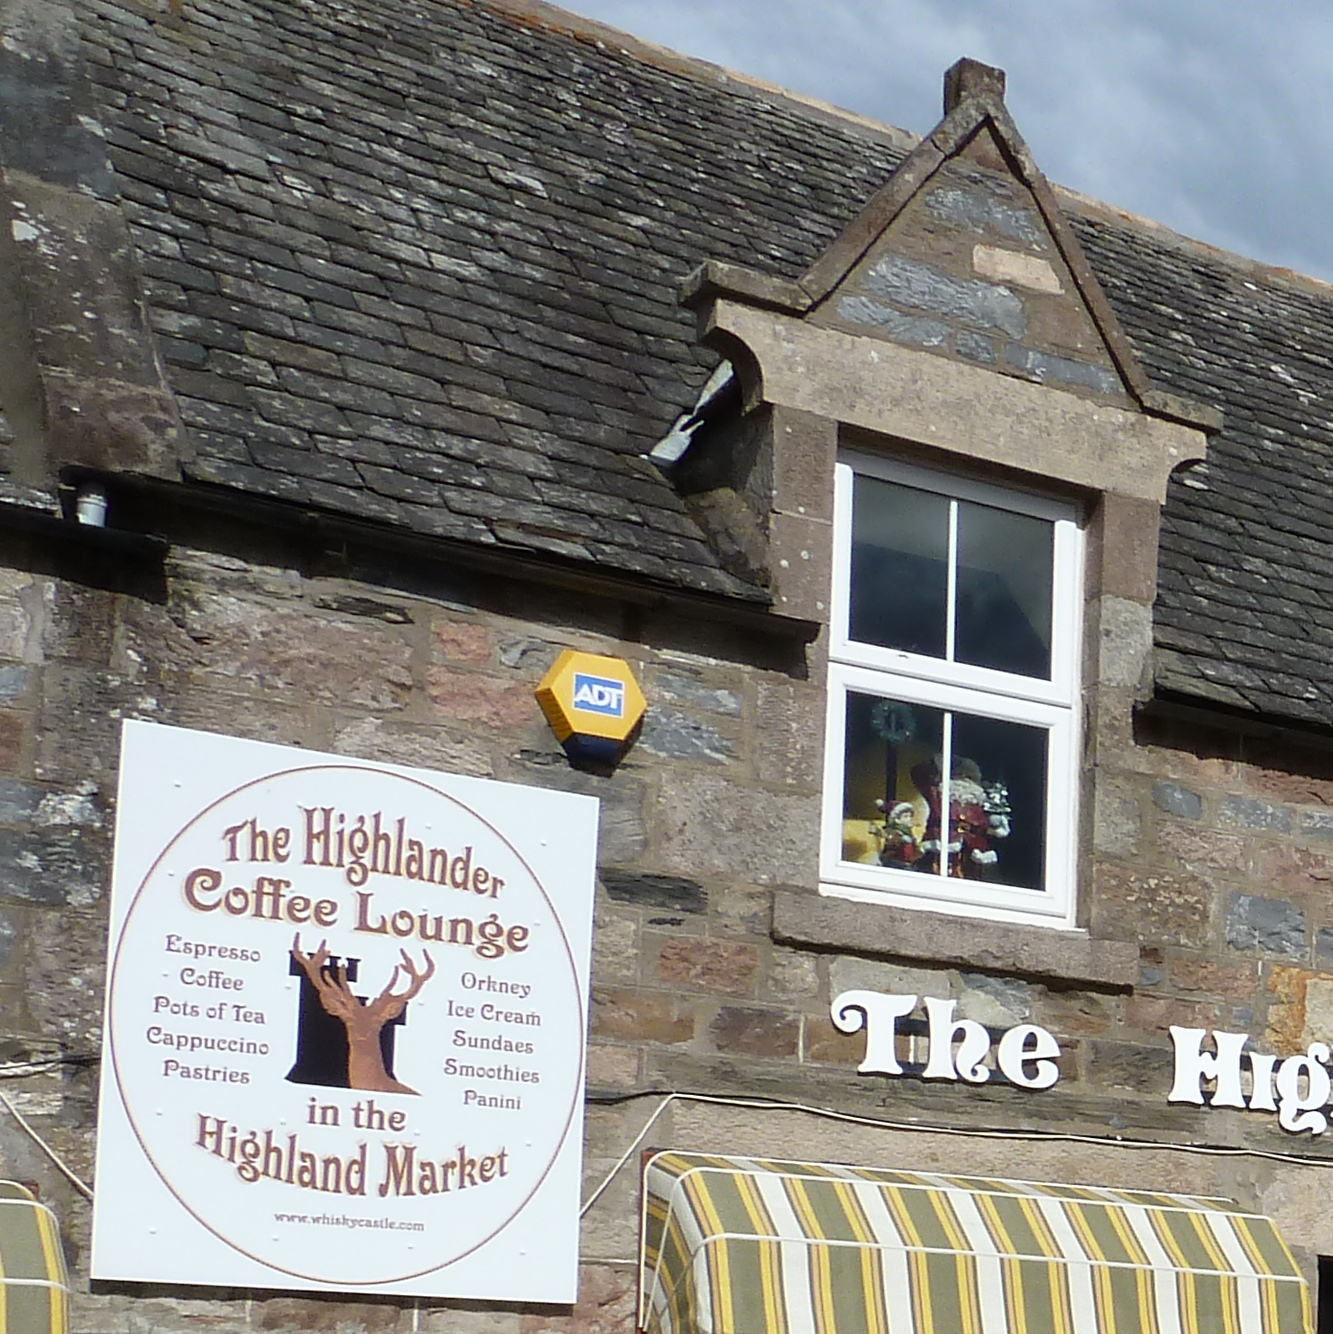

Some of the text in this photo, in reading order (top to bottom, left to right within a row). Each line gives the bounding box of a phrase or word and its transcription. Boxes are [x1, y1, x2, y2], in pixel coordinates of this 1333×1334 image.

[574, 683, 623, 709] ADT
[224, 806, 505, 899] The Highlander
[185, 868, 530, 959] Coffee Lounge
[165, 934, 261, 962] Espresso
[180, 967, 244, 991] Coffee
[461, 972, 531, 999] Orkney
[154, 996, 266, 1025] Pots of Tea
[447, 1000, 541, 1026] Ice Cream
[146, 1026, 270, 1056] Cappuccino
[452, 1030, 534, 1054] Sundaes
[830, 989, 1061, 1089] The
[163, 1059, 250, 1085] Pastries
[444, 1058, 540, 1084] Smoothies
[463, 1089, 522, 1110] Panini
[307, 1097, 406, 1132] in the
[195, 1112, 509, 1197] Highland Market
[273, 1212, 425, 1231] www.whiskycastle.com
